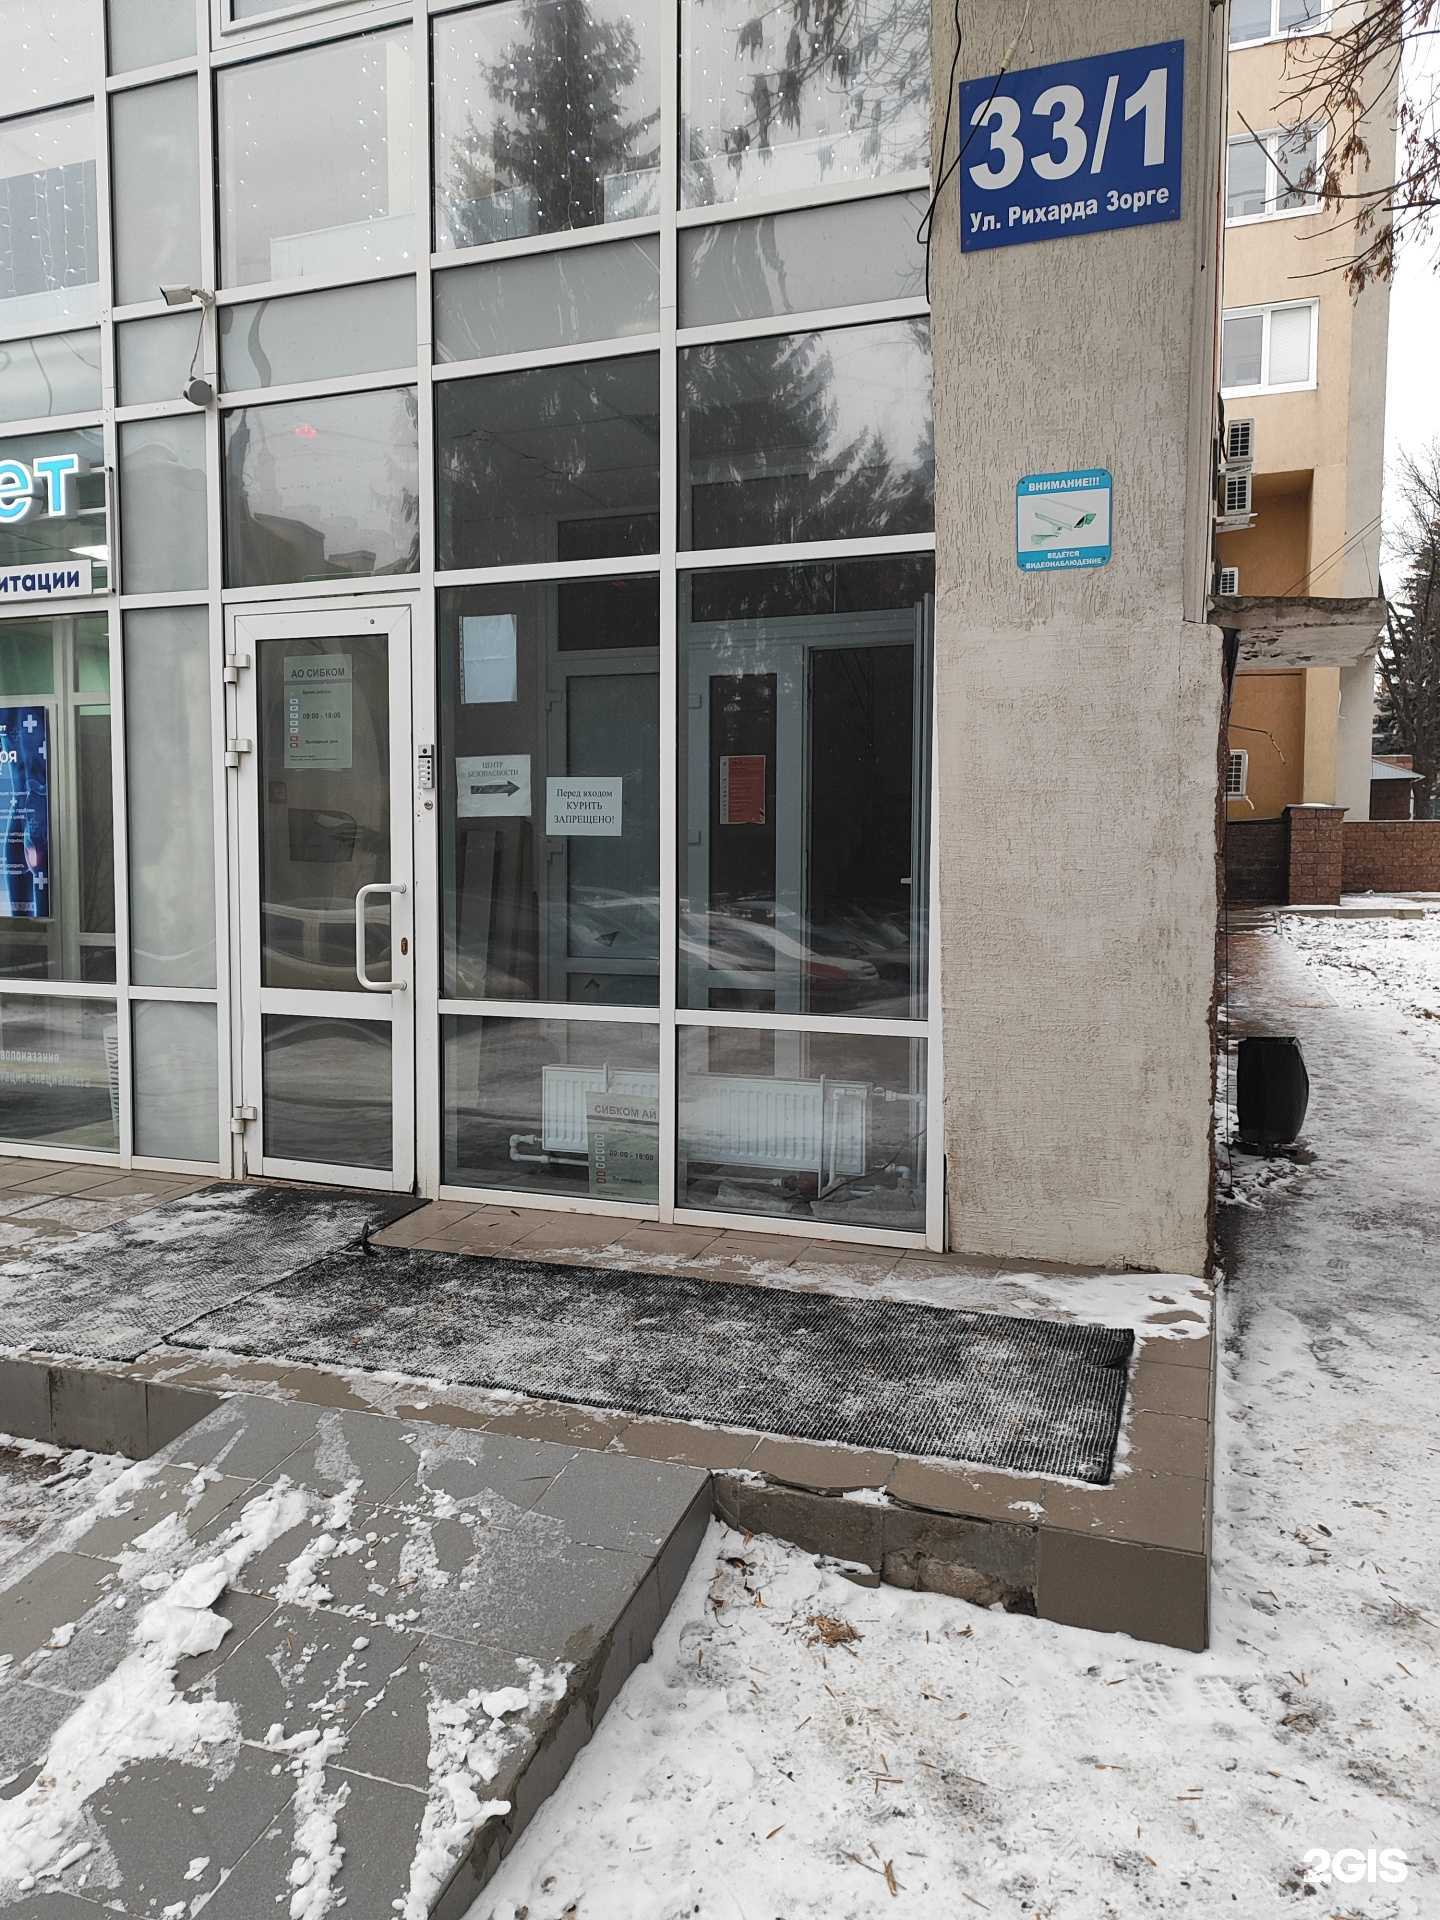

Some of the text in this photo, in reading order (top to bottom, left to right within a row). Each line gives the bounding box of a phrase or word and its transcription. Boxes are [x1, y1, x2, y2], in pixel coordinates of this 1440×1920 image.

[969, 67, 1168, 190] 33/1
[970, 187, 1169, 232] Ул. Рихарда Зорге
[1028, 477, 1099, 491] ВНИМАНИЕ!!!
[1025, 557, 1103, 570] ВИДЕОНАБЛЮДЕНИЕ
[291, 667, 345, 678] АО СИБКОМ
[556, 788, 613, 799] Перед входом
[566, 801, 603, 810] КУРИТЬ
[553, 814, 615, 825] ЗАПРЕЩЕНО!
[594, 1104, 639, 1118] СИБКОМ
